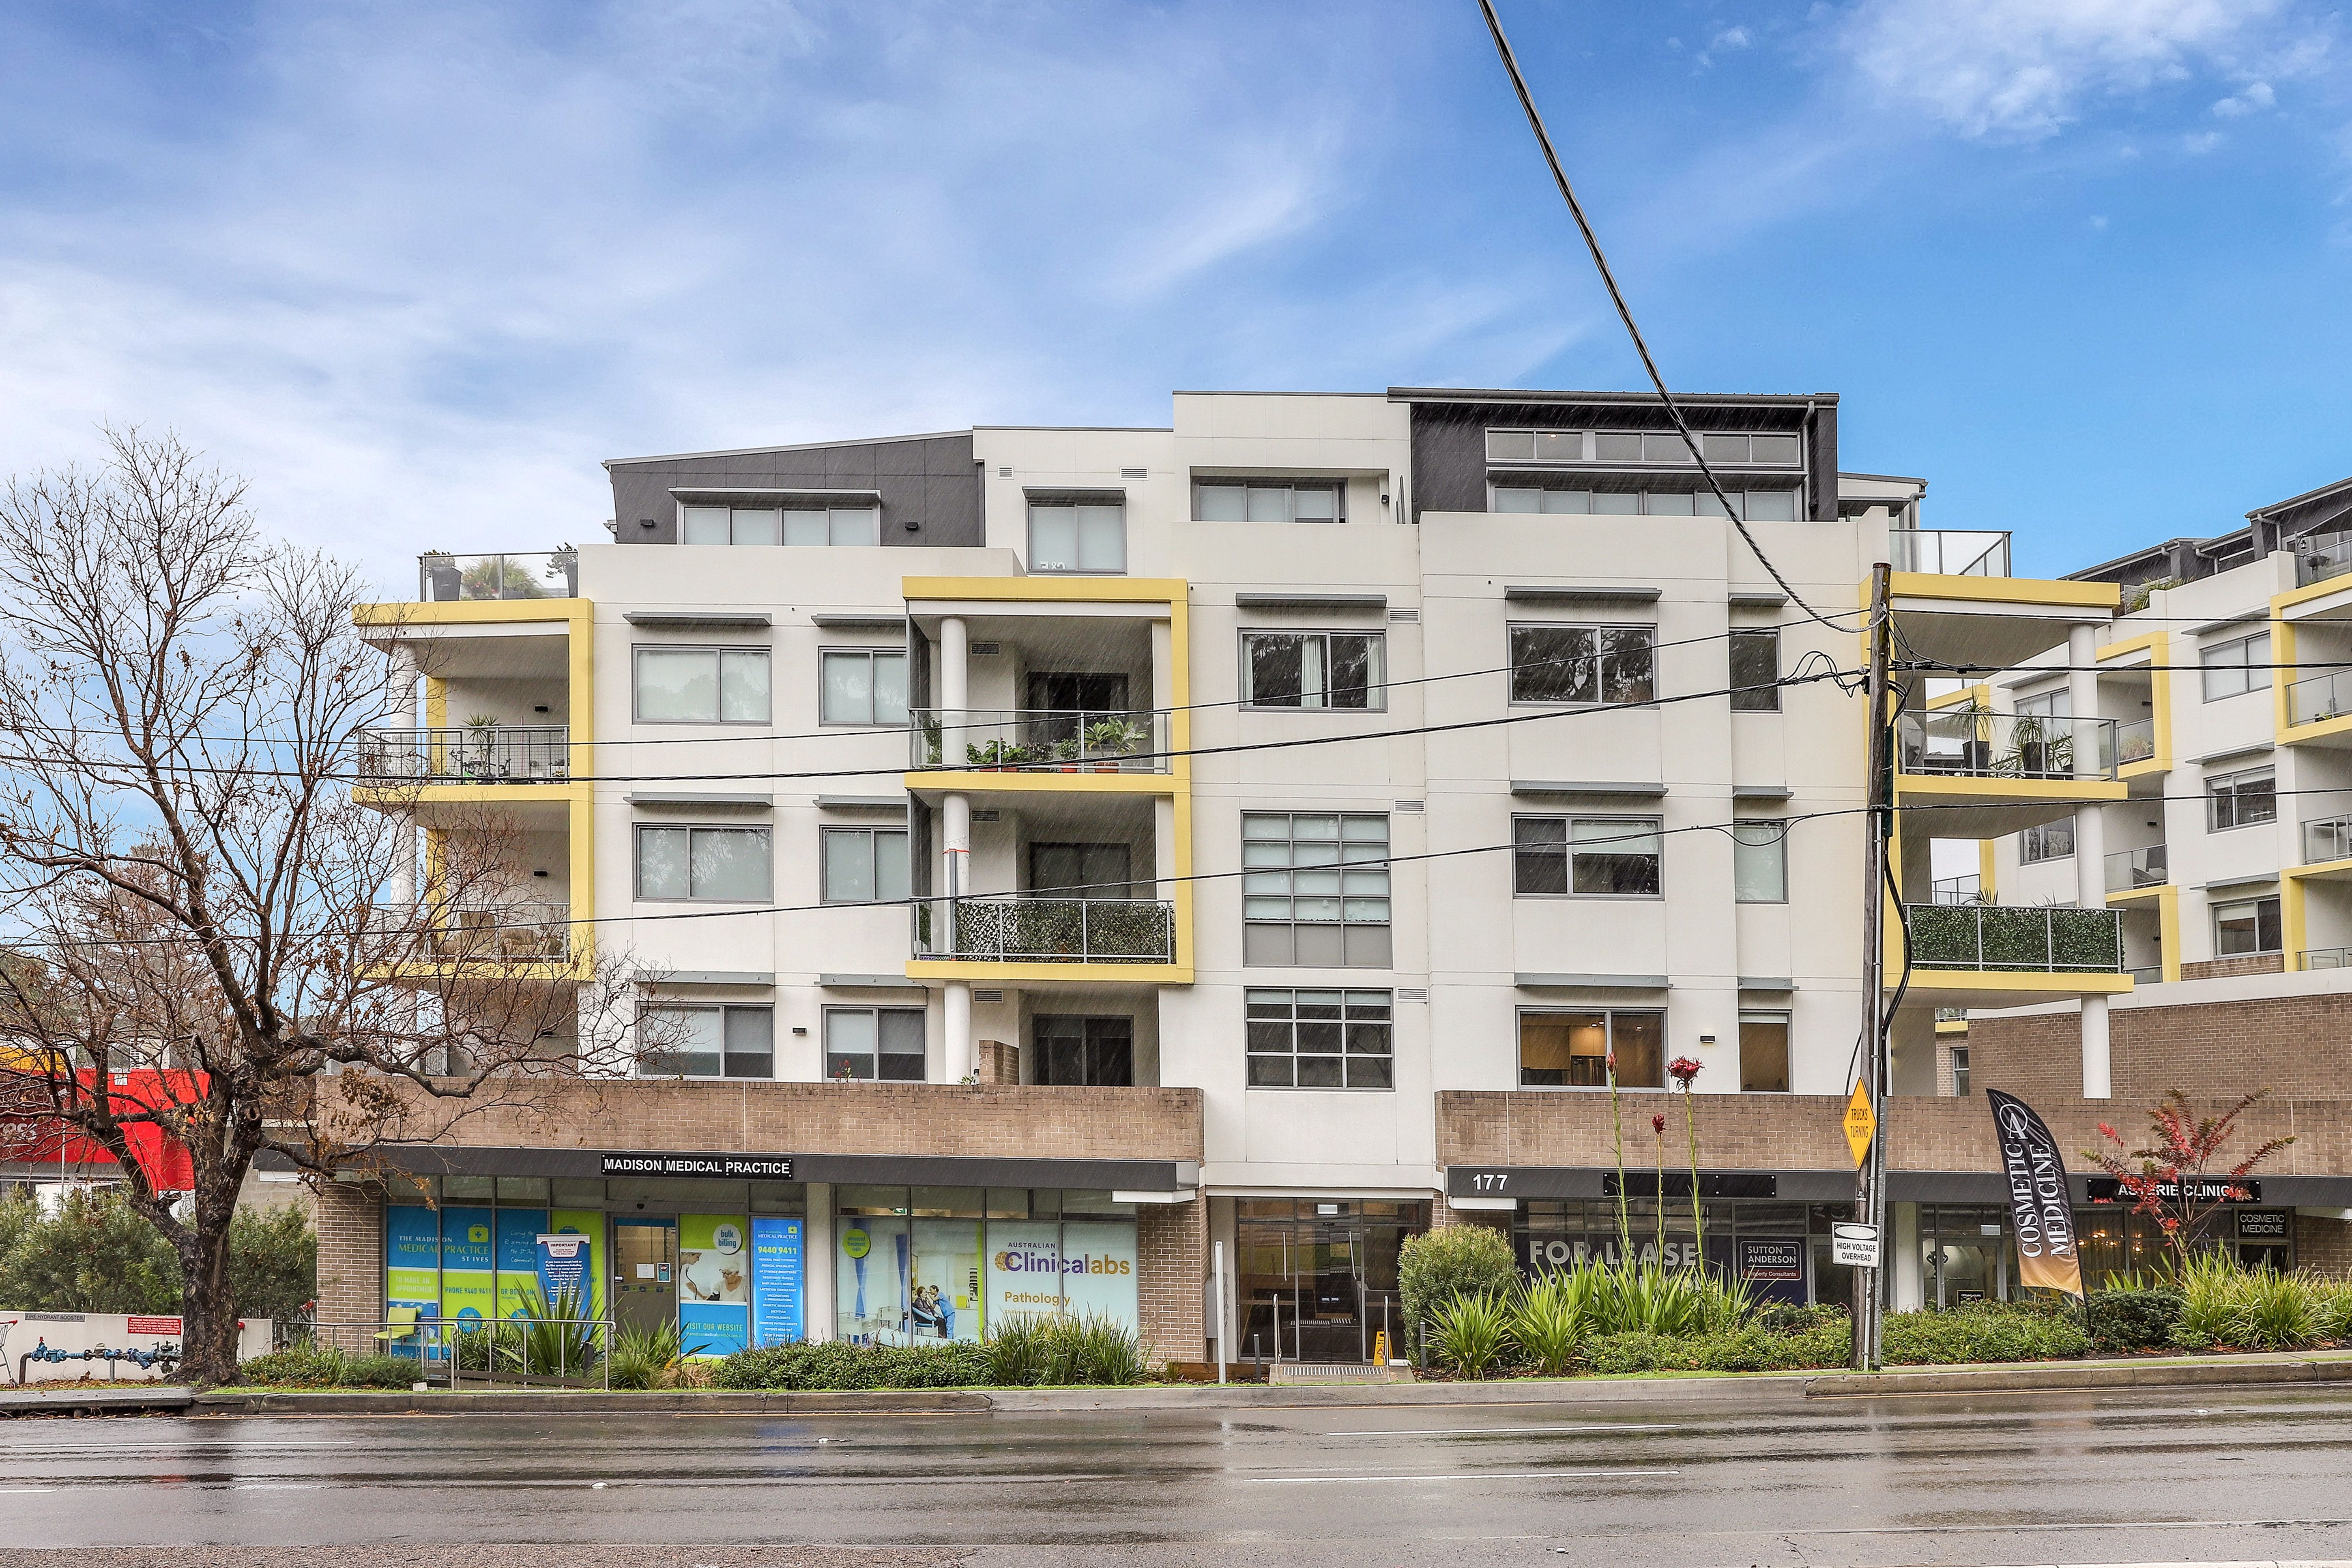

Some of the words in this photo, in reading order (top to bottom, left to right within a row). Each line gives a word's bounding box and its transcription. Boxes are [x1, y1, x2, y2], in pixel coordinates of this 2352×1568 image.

[1851, 1108, 1868, 1121] TRUCKS
[1850, 1126, 1869, 1138] TURNING
[604, 1159, 662, 1171] MADISON
[666, 1160, 722, 1172] MEDICAL
[726, 1162, 790, 1174] PRACTICE
[1473, 1173, 1508, 1190] 177
[2118, 1184, 2178, 1196] ASRIE
[2183, 1185, 2230, 1196] CLINIC
[2005, 1143, 2043, 1258] COSMETIC
[2029, 1144, 2071, 1257] MEDICINE
[2240, 1214, 2285, 1222] COSMETIC
[398, 1244, 438, 1253] MEDICAL
[445, 1246, 488, 1254] PRACTICE
[718, 1238, 736, 1248] billing
[1837, 1242, 1851, 1250] HIGH
[1852, 1243, 1876, 1252] VOLTAGE
[1530, 1241, 1593, 1264] FOR
[1748, 1246, 1782, 1254] SUTTON
[1748, 1255, 1796, 1263] ANDERSON
[1842, 1252, 1871, 1261] OVERHEAD
[1005, 1252, 1130, 1274] Clinicalabs
[395, 1285, 435, 1293] APPOINTMENT
[1005, 1291, 1070, 1306] Pathology
